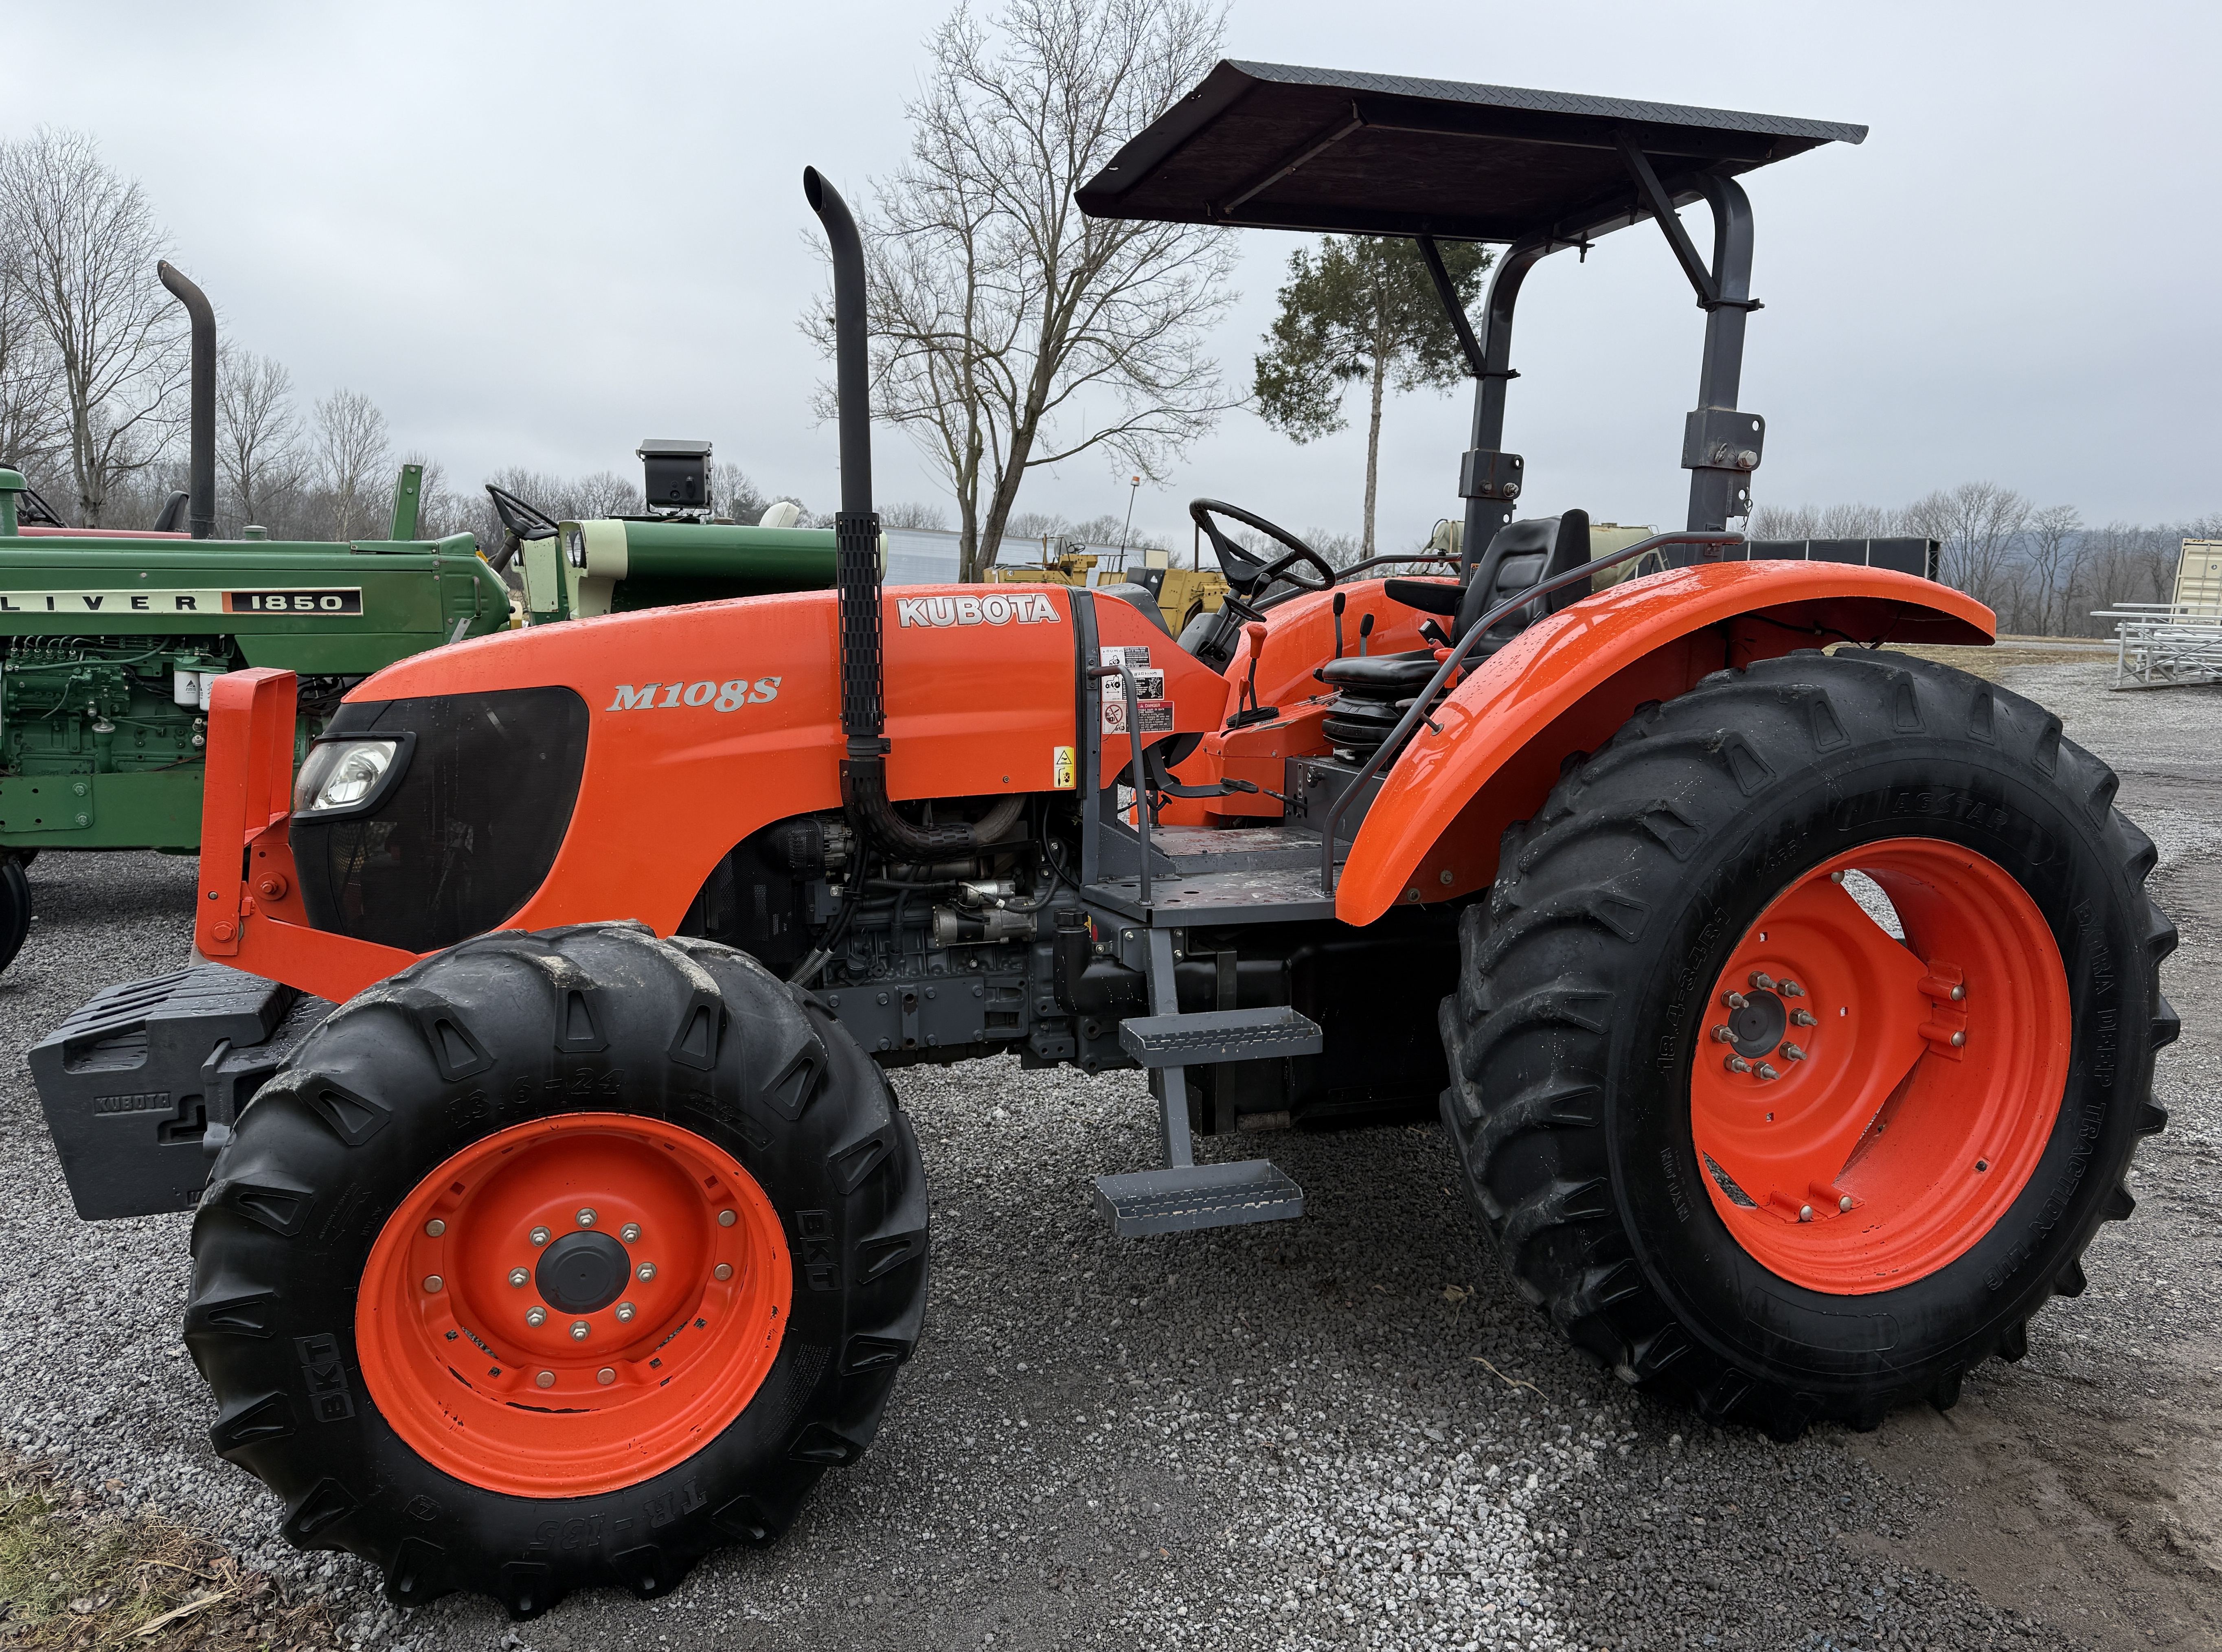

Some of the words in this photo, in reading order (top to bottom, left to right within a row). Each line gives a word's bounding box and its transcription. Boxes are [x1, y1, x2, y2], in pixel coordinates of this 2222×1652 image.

[252, 595, 343, 610] 1850
[896, 593, 1061, 628] KUBOTA
[605, 676, 783, 713] M108S
[1891, 792, 2010, 832] AGSTAR
[2073, 899, 2116, 995] EXTRA
[2094, 1009, 2117, 1087] DEEP
[94, 1093, 171, 1113] KUBOTA
[2036, 1103, 2108, 1240] TRACTION
[795, 1209, 843, 1291] BKT
[1983, 1239, 2031, 1291] LUG
[293, 1333, 356, 1423] BKT
